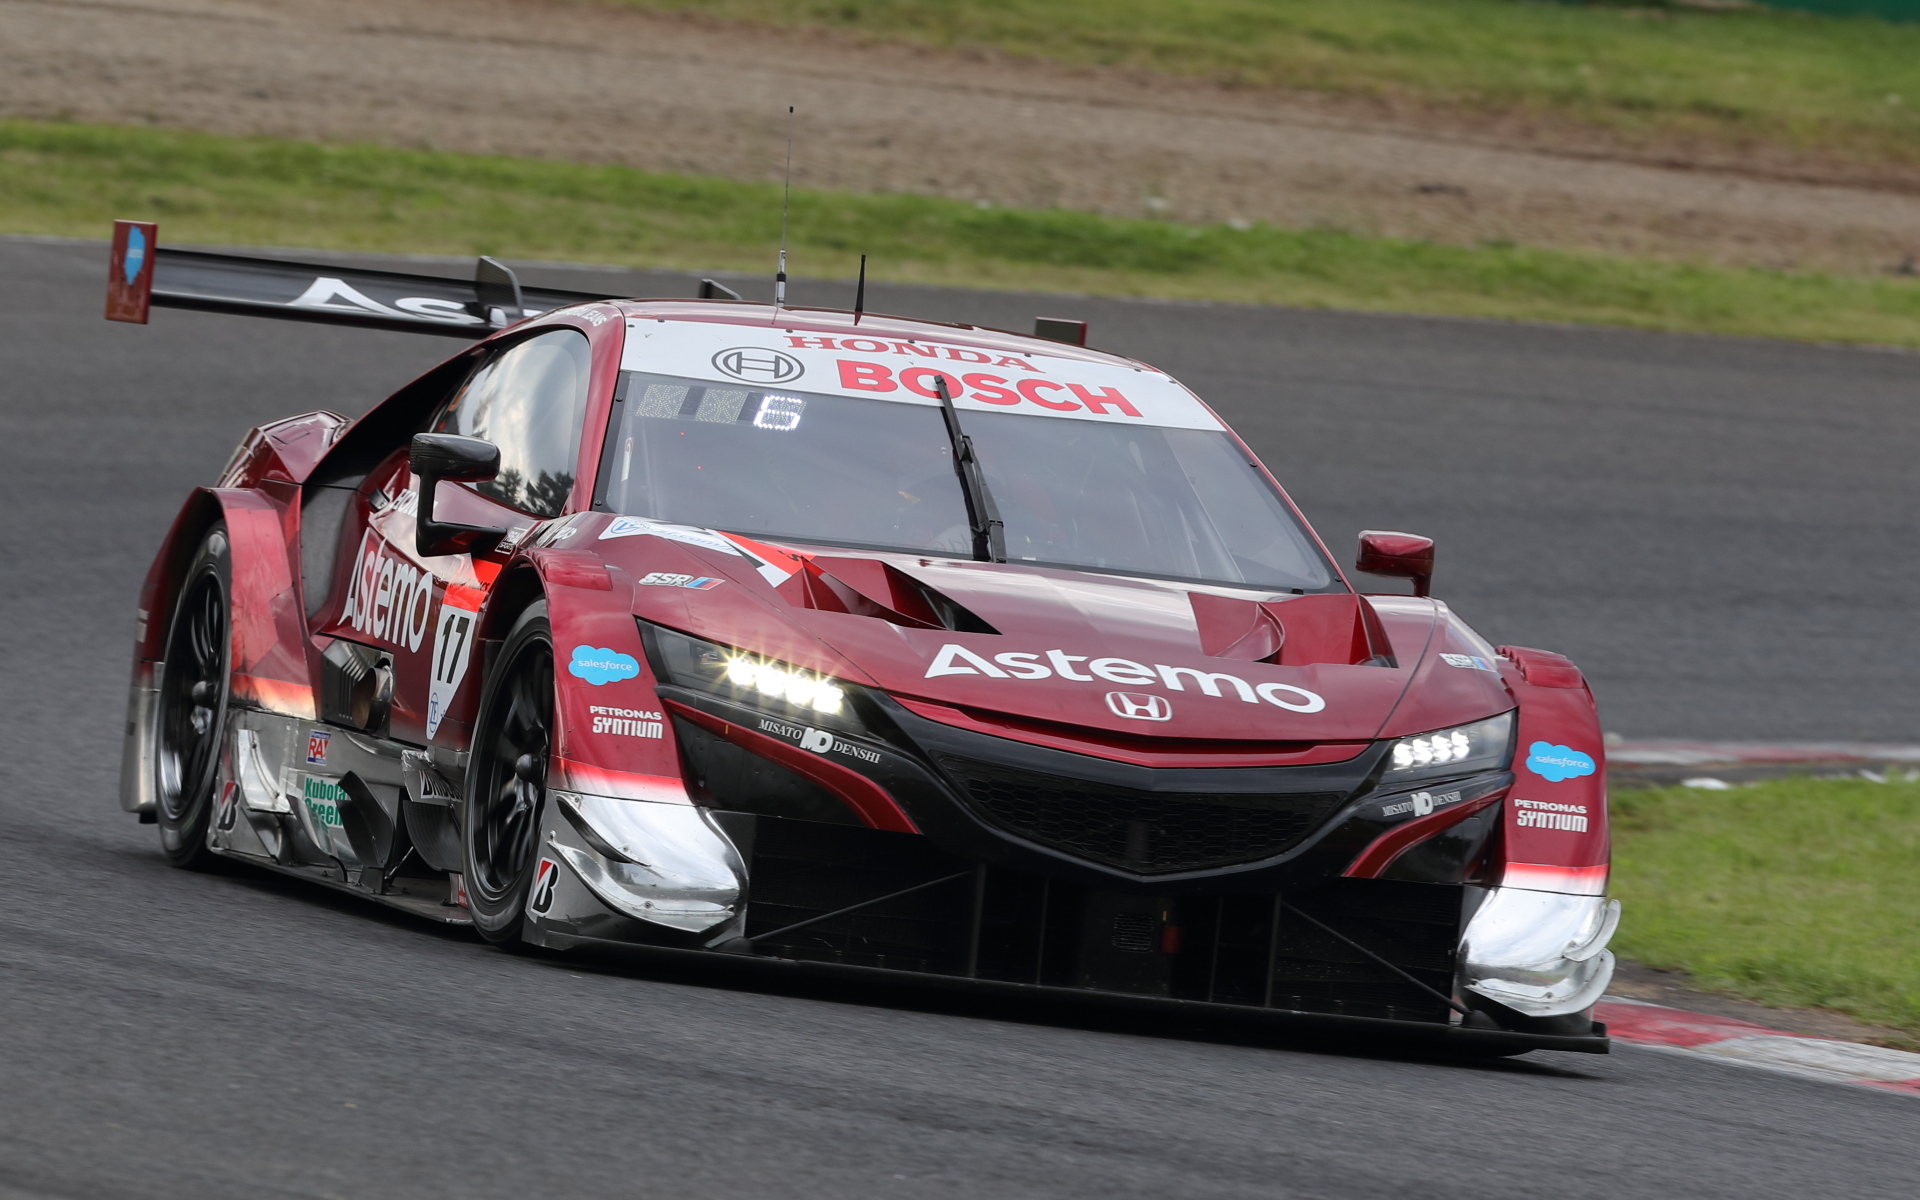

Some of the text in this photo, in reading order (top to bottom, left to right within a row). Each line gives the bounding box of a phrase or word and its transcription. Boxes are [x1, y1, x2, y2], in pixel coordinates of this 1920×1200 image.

[783, 334, 1047, 373] HONDA
[836, 358, 1144, 418] BOSCH
[337, 526, 433, 653] Astemo
[640, 572, 692, 587] SSR
[437, 614, 470, 684] 17
[577, 658, 633, 671] salesforce
[924, 643, 1327, 714] Astemo
[589, 705, 662, 720] PETRONAS
[592, 716, 663, 739] SYNTIUM
[758, 719, 803, 740] MISATO
[832, 741, 881, 764] DENSHI
[1535, 755, 1590, 769] salesforce
[304, 777, 347, 801] Kubota
[1513, 798, 1588, 814] PETRONAS
[1516, 809, 1589, 833] SYNTIUM
